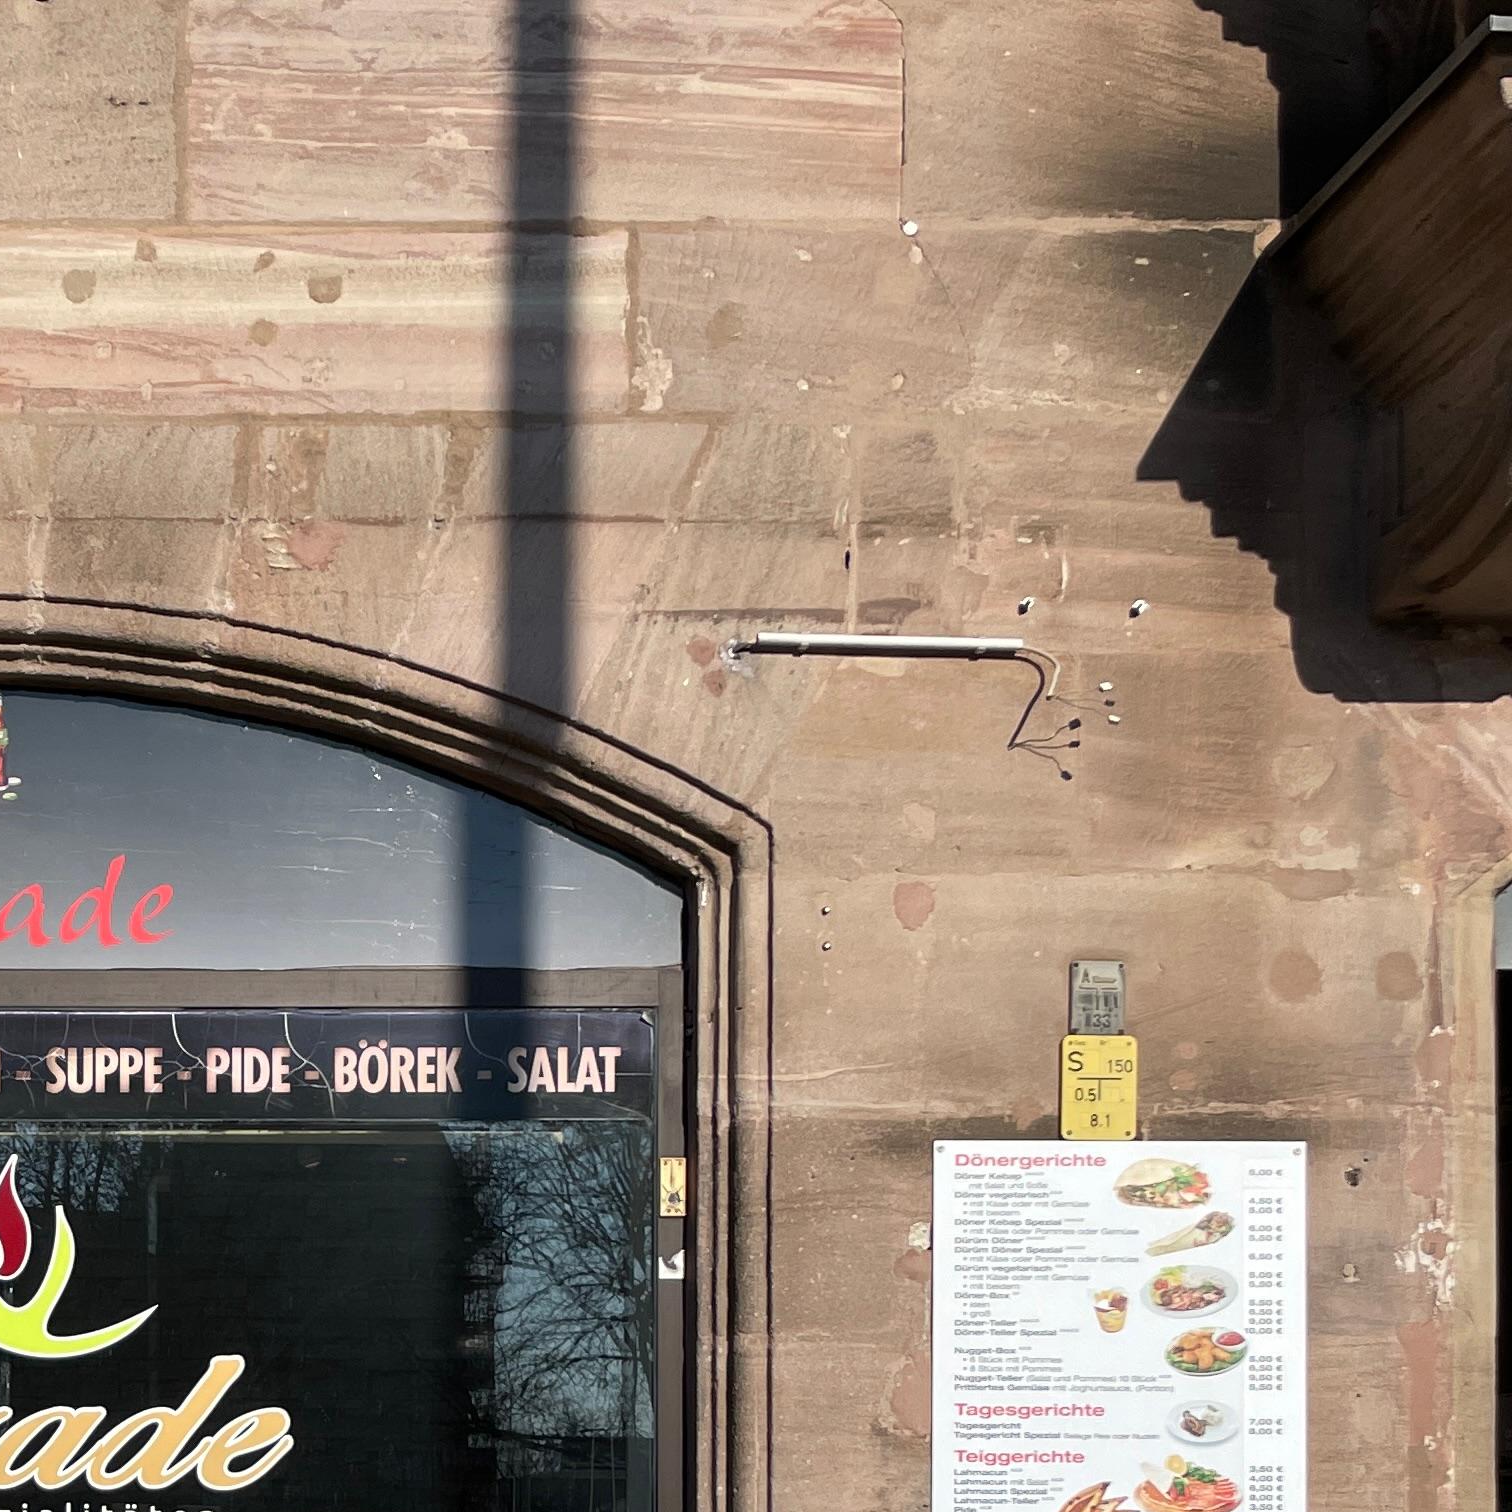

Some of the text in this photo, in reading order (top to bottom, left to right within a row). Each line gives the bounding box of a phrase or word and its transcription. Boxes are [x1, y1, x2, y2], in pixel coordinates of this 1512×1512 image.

[46, 1047, 163, 1093] SUPPE
[206, 1047, 291, 1094] PIDE
[334, 1039, 461, 1093] BÖREK
[507, 1046, 621, 1093] SALAT
[1068, 1051, 1133, 1073] S 150
[955, 1154, 1106, 1170] Dönergerichte
[955, 1403, 1104, 1419] Tagesgerichte
[955, 1450, 1084, 1466] Teiggerichte
